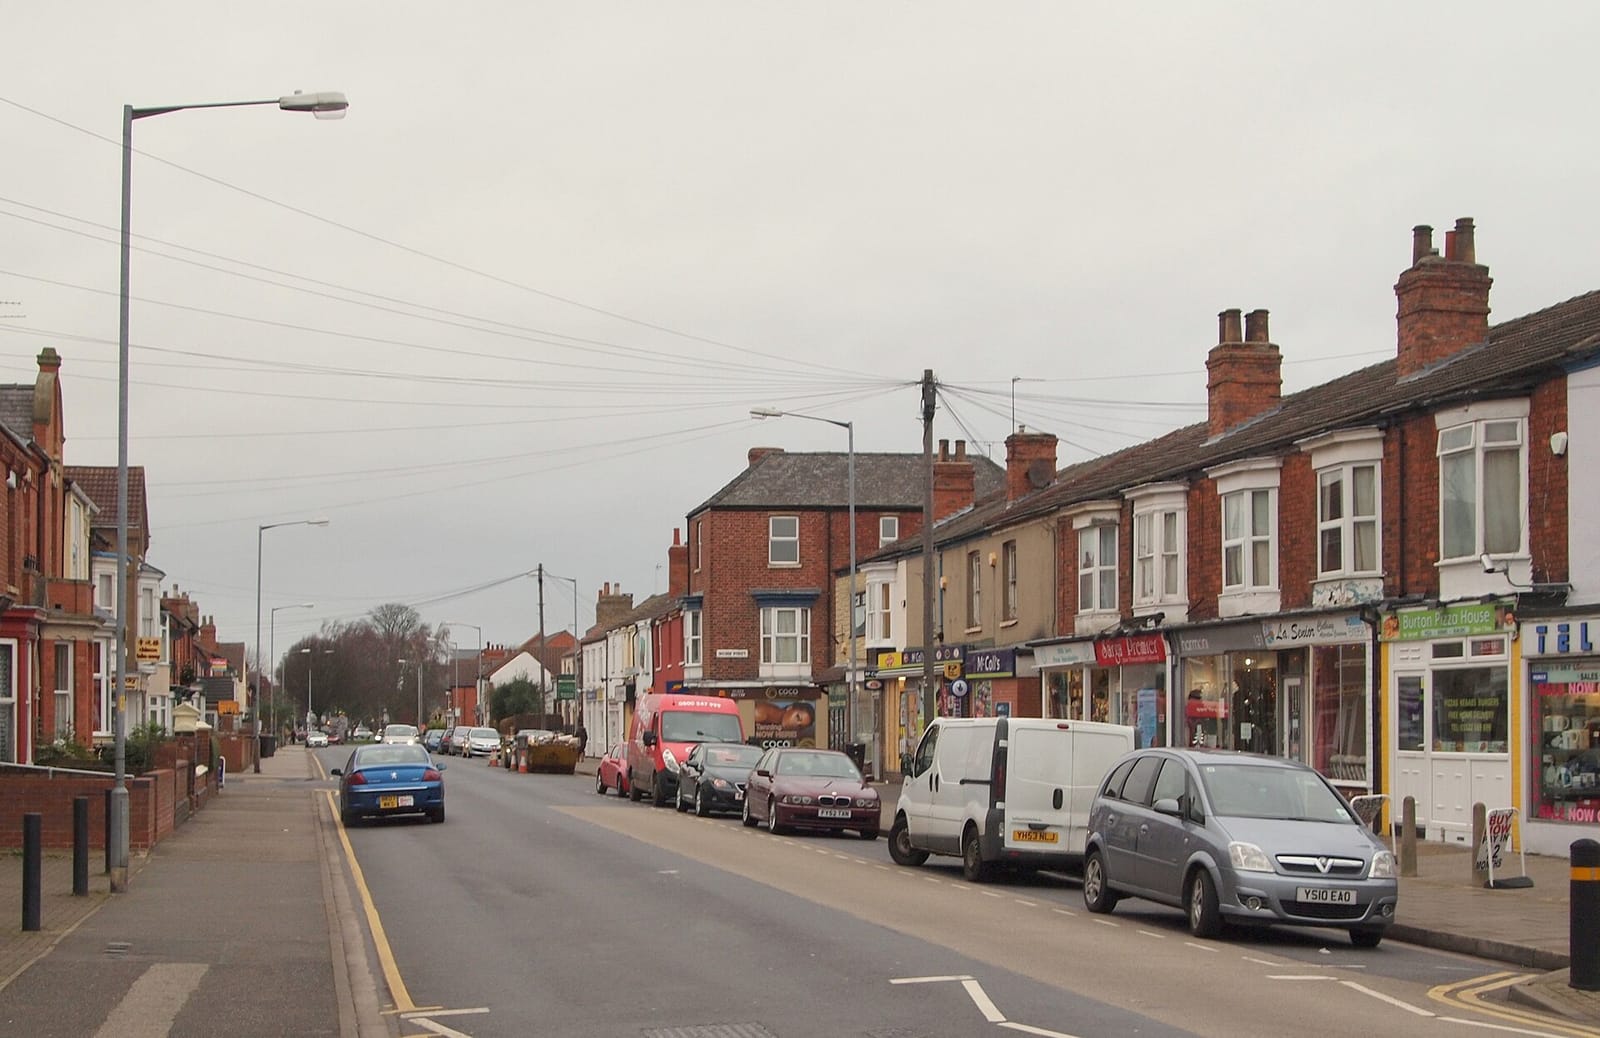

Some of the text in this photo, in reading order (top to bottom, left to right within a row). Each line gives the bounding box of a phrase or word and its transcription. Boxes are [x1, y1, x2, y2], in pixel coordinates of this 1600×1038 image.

[1403, 610, 1490, 629] Burton Pizza House
[1580, 672, 1599, 681] SALES
[778, 688, 799, 696] COCO
[1568, 683, 1594, 695] NOW
[762, 740, 790, 749] COCO
[1490, 815, 1511, 825] BUY
[1568, 808, 1594, 821] NOW
[1304, 889, 1328, 901] YS10
